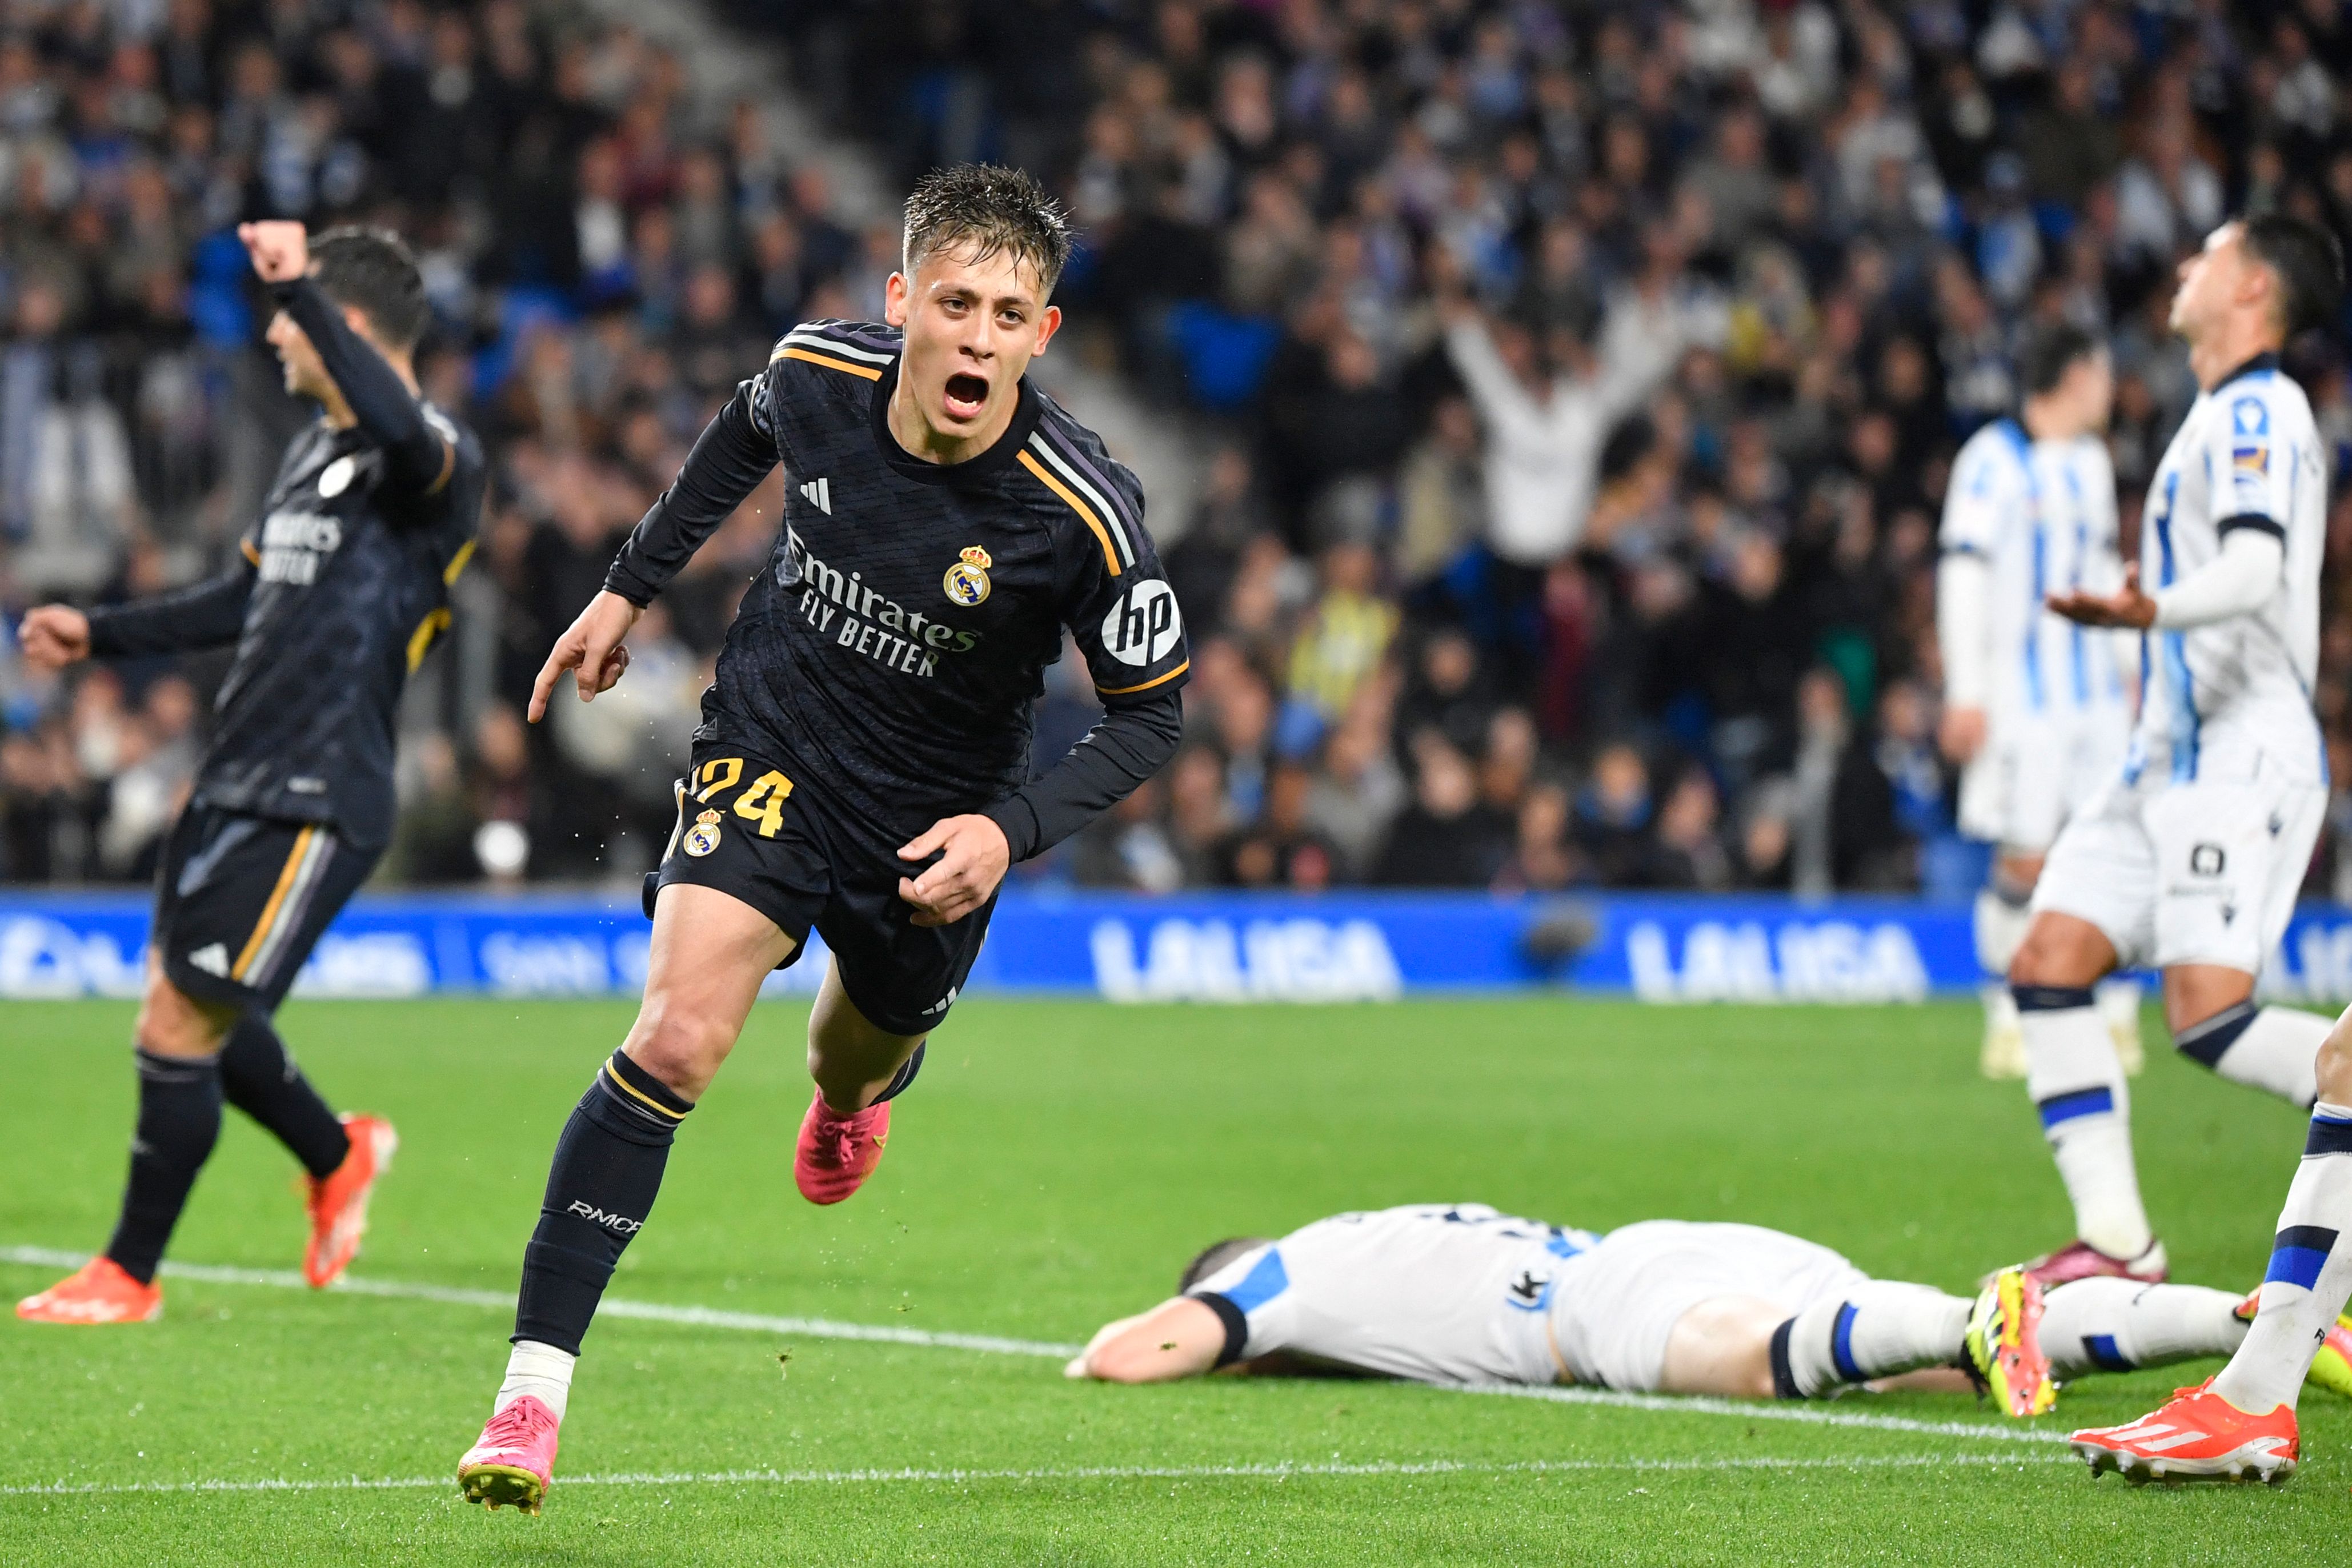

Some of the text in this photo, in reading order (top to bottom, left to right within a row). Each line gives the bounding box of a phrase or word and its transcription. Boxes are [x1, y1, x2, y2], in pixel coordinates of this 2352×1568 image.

[788, 523, 981, 652] Emirates
[1111, 582, 1175, 667] hp
[800, 588, 939, 677] FLY BETTER
[695, 757, 795, 839] 24
